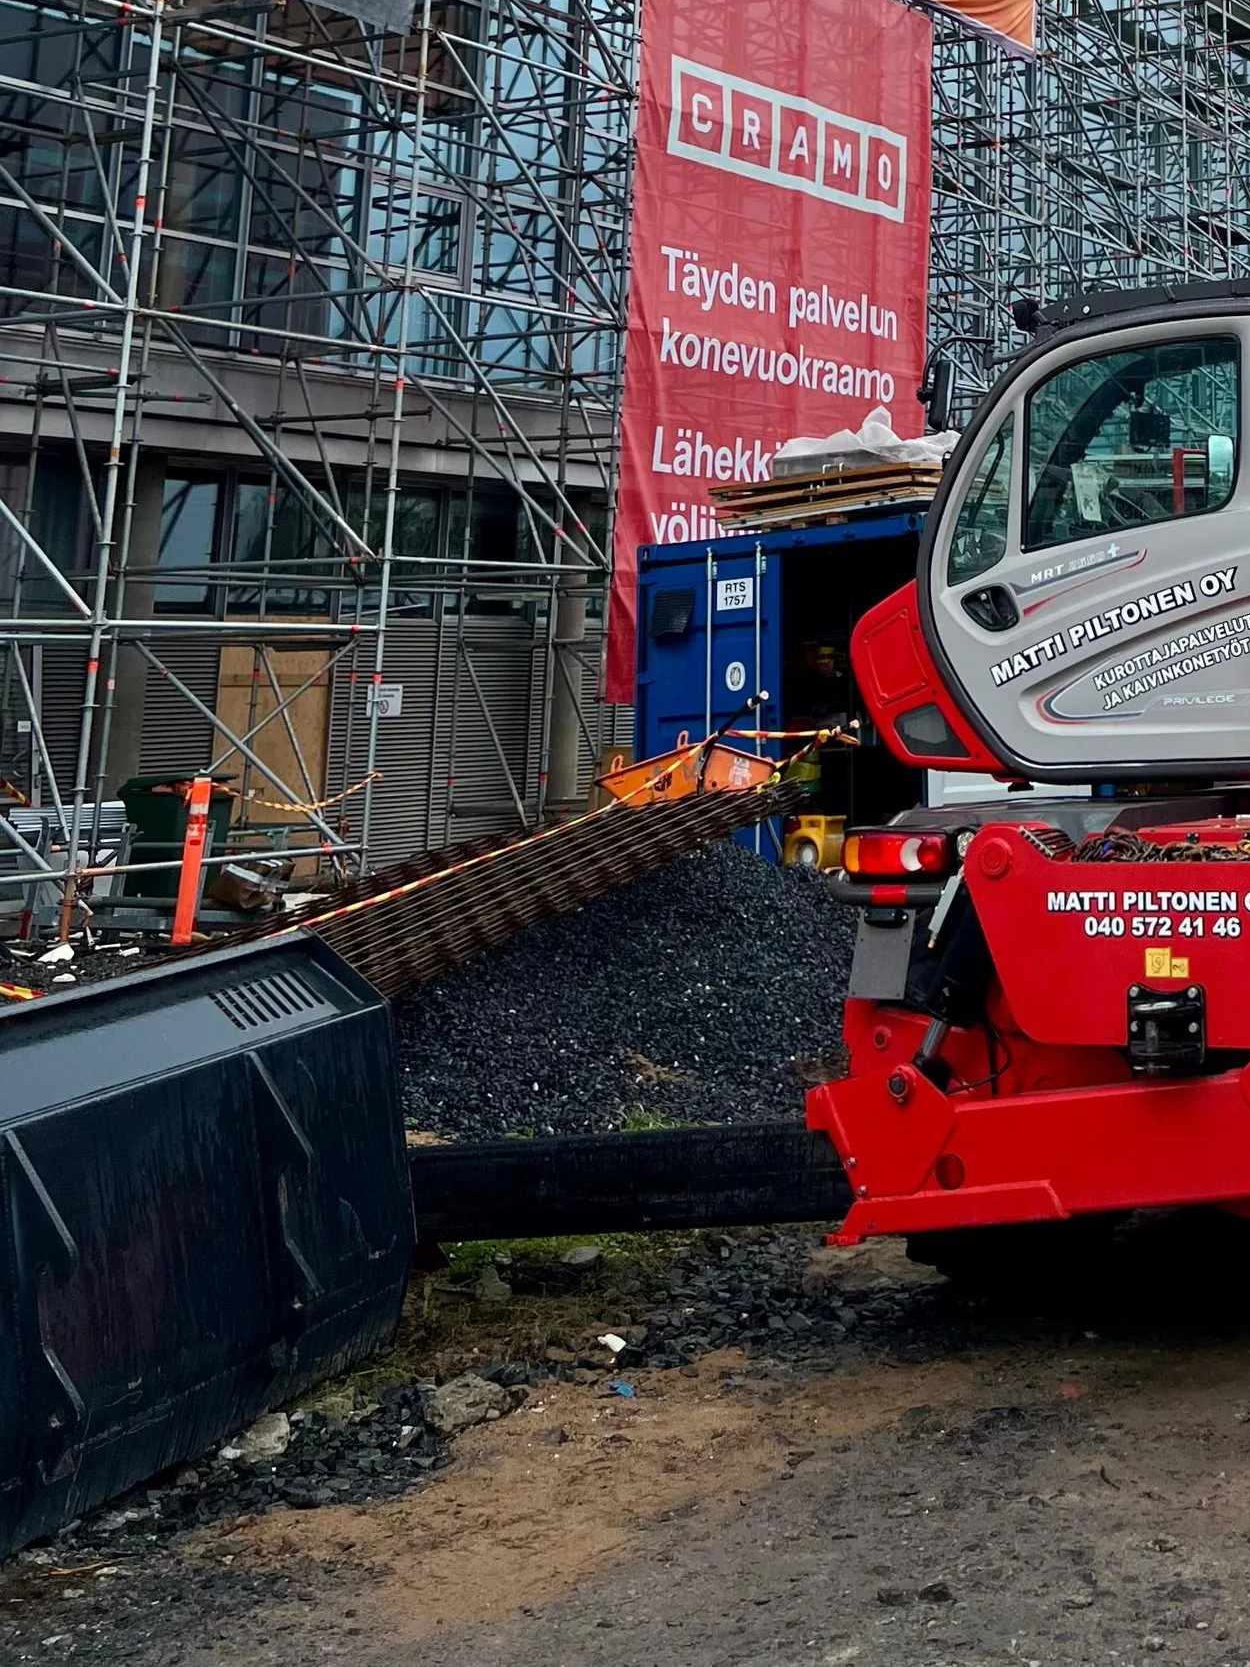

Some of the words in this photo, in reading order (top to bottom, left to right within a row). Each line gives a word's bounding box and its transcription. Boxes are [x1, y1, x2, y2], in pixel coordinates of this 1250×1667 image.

[691, 92, 892, 191] CRAMO
[660, 245, 777, 314] Täyden
[788, 284, 899, 341] palvelun
[659, 317, 896, 404] konevuokraamo
[652, 425, 788, 483] Lähekk
[724, 581, 746, 594] RTS
[1030, 563, 1065, 583] MRT
[723, 594, 747, 607] 1757
[989, 632, 1066, 686] MATTI
[1068, 580, 1196, 648] PILTONEN
[1199, 566, 1237, 597] OY
[1102, 690, 1123, 711] JA
[1121, 637, 1250, 701] KAIVINKONETYÖT
[1163, 694, 1235, 706] PRIVILEGE
[1047, 891, 1116, 912] MATTI
[1122, 891, 1238, 912] PILTONEN
[1084, 916, 1125, 937] 040
[1131, 916, 1172, 937] 572
[1177, 916, 1204, 937] 41
[1212, 916, 1241, 937] 46
